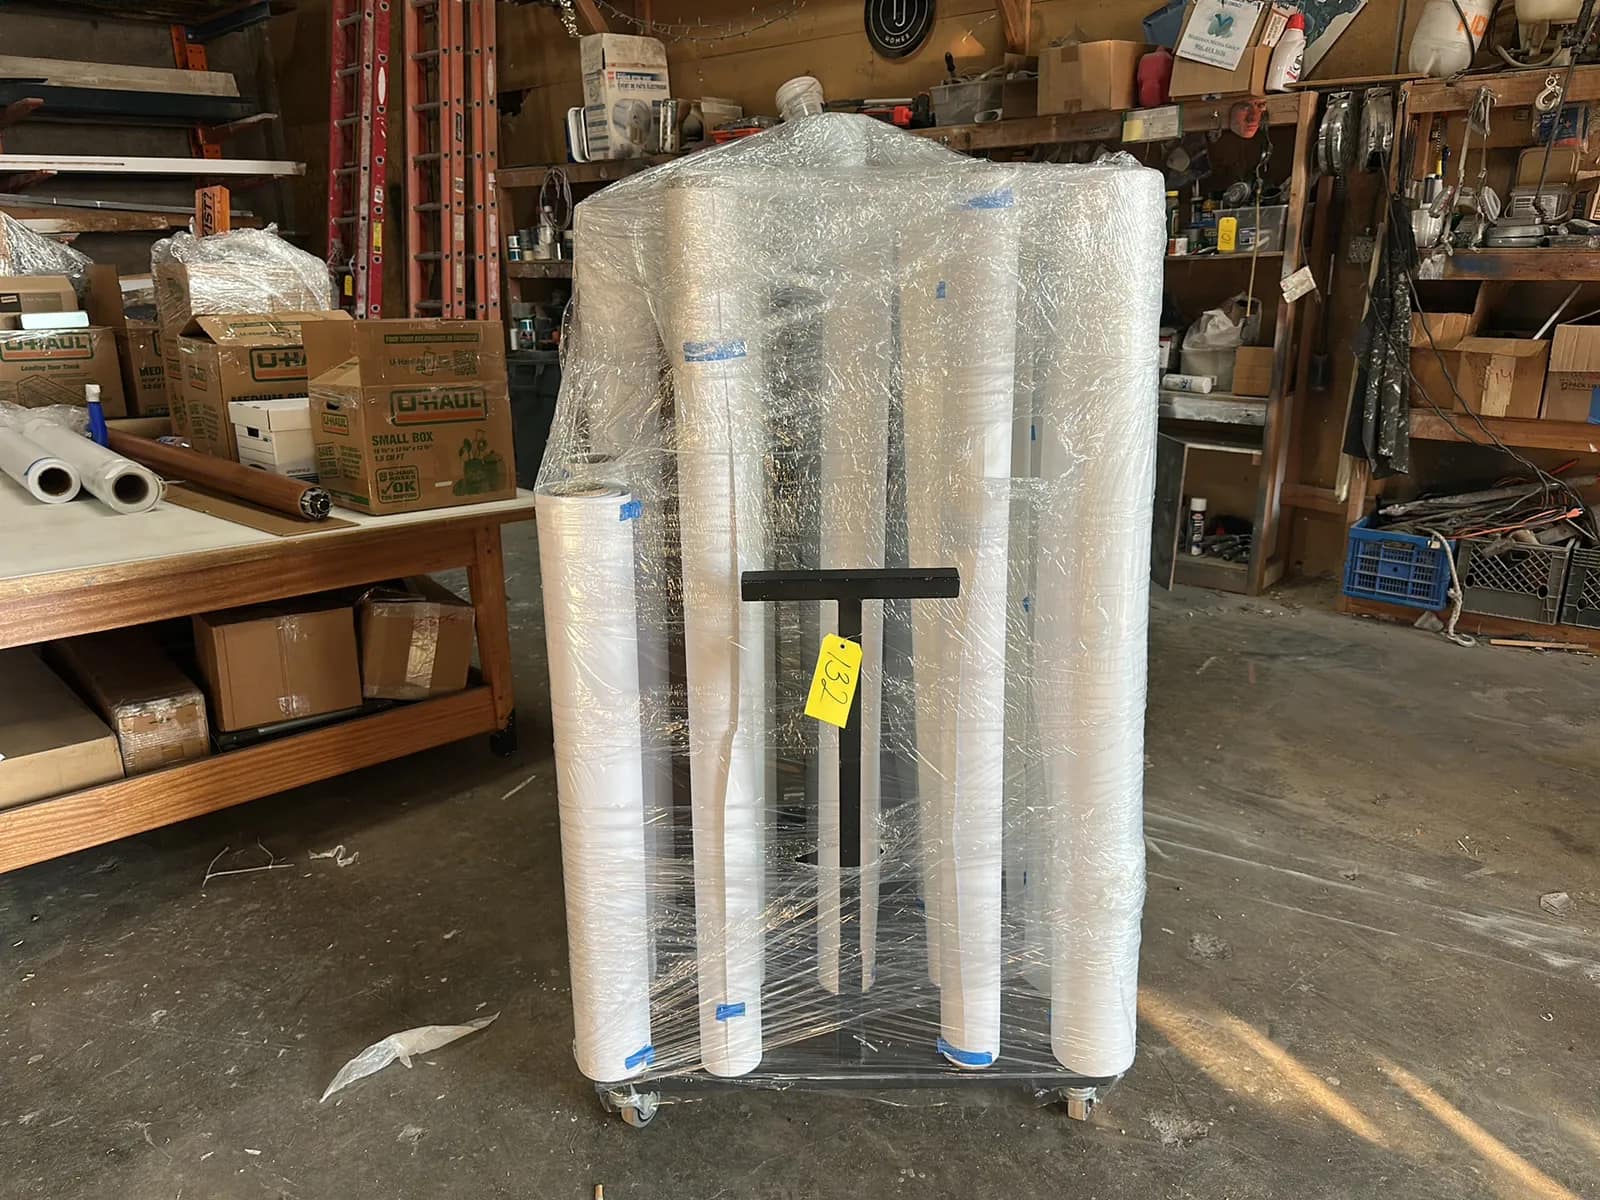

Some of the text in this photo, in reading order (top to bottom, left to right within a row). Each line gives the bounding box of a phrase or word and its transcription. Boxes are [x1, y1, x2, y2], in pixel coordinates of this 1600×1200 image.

[5, 336, 87, 350] U-HAUL
[399, 391, 482, 412] U-HAUL
[323, 415, 347, 428] U-HAUL
[371, 431, 434, 446] SMALL BOX
[392, 480, 416, 492] OK
[820, 651, 852, 705] 132
